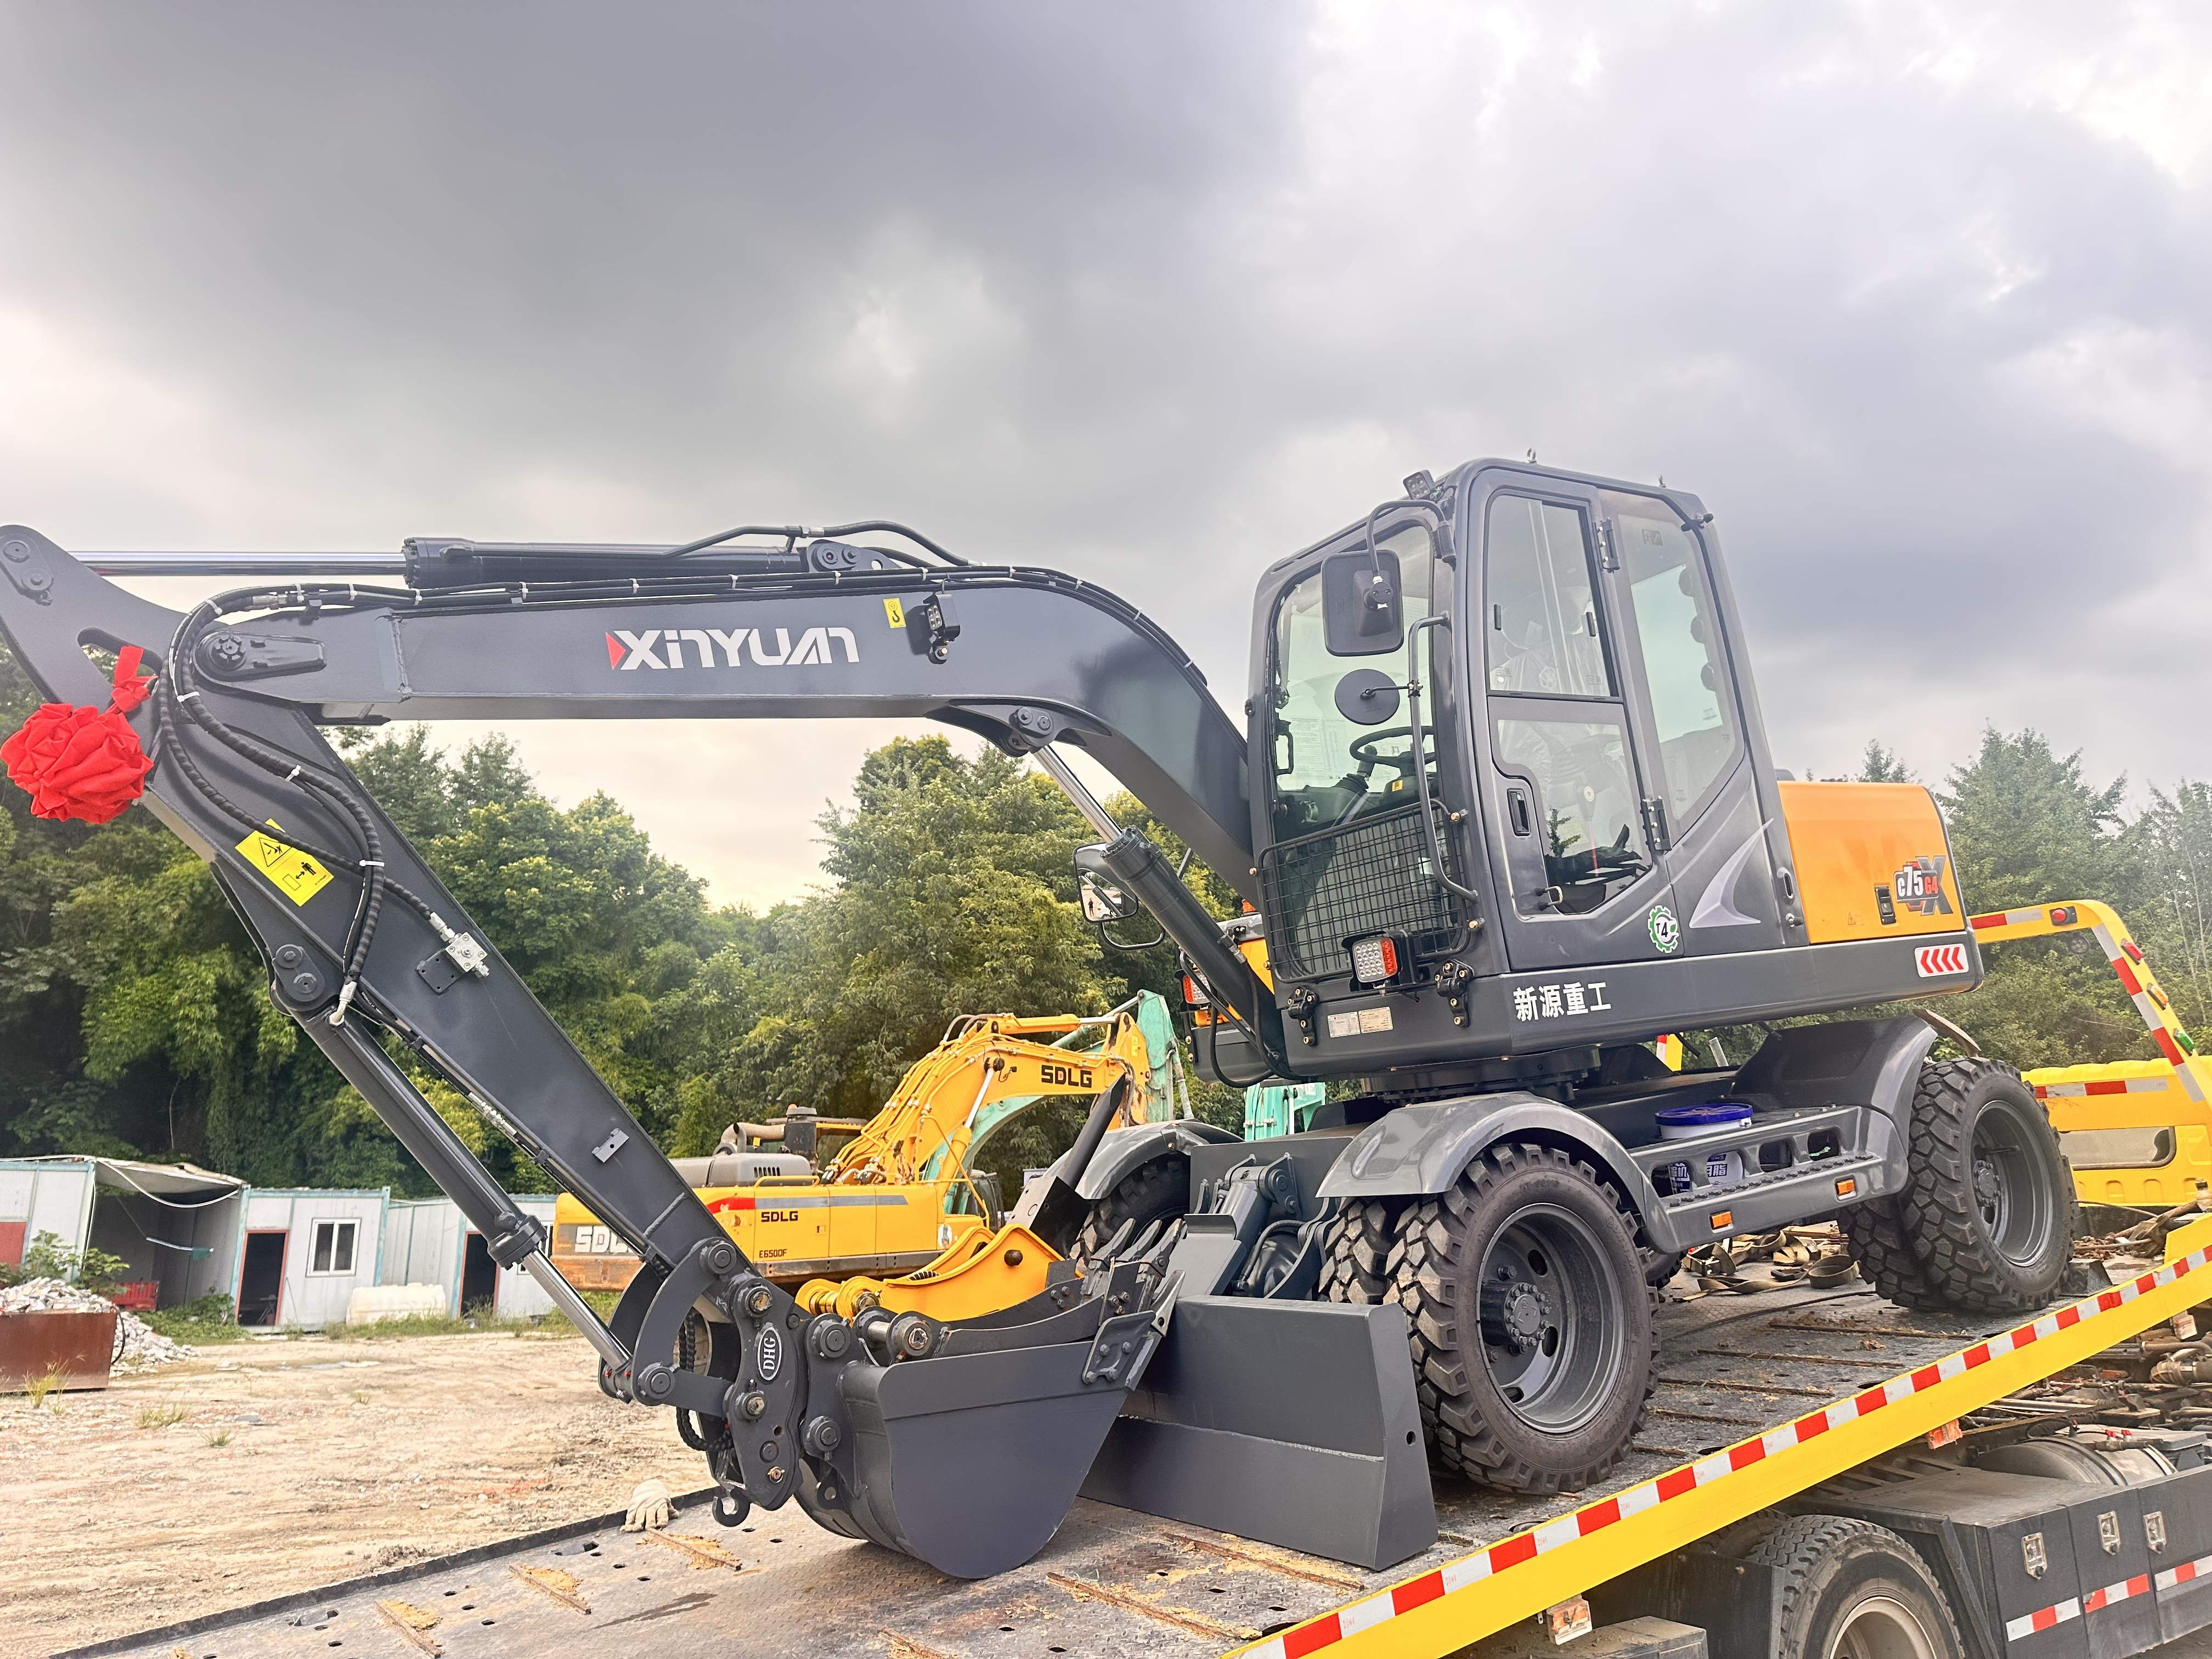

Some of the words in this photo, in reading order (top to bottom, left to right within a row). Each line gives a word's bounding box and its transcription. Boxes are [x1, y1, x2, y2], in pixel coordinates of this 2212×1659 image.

[1513, 981, 1611, 1022] 新源重工
[1041, 1064, 1092, 1088] SDLG
[761, 1211, 798, 1222] SDLG
[574, 1225, 634, 1254] SDL
[759, 1249, 788, 1259] E6500F
[763, 1336, 776, 1370] DHG
